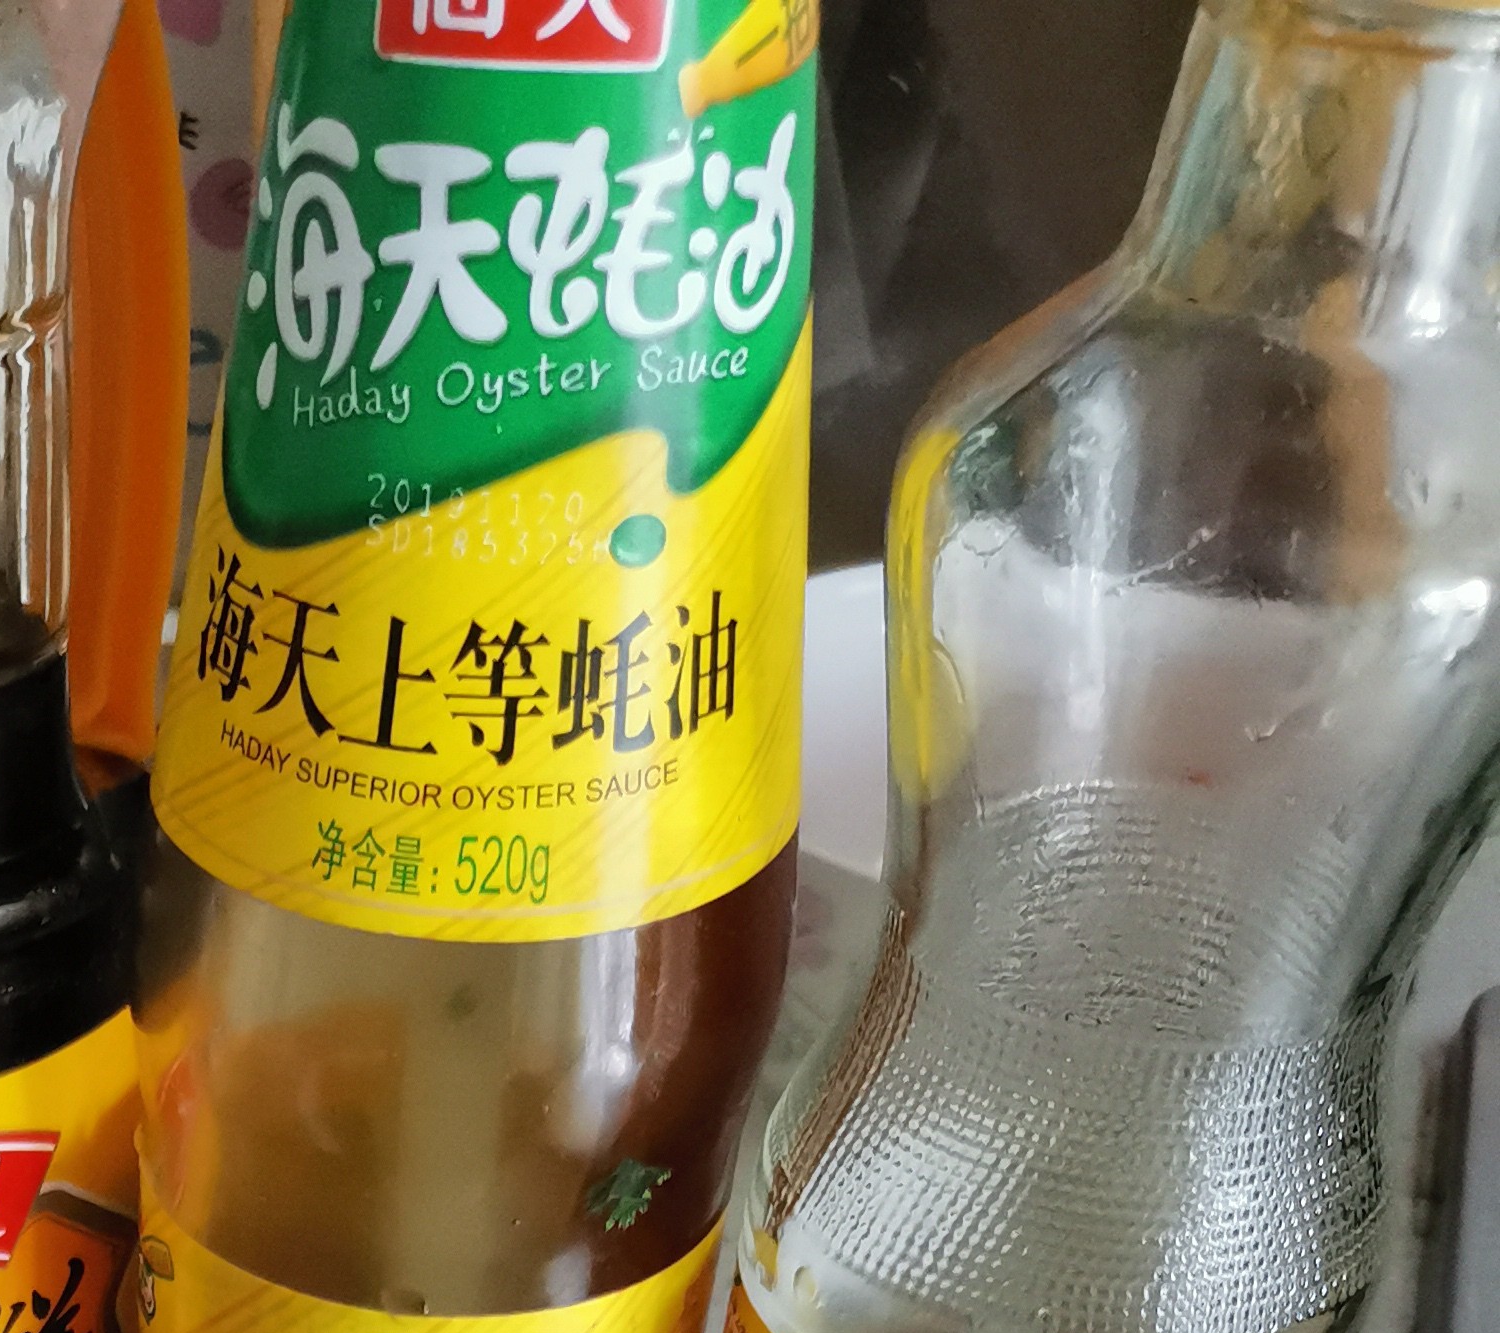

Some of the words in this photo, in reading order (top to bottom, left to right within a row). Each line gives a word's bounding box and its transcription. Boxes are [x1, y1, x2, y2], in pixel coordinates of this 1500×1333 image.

[247, 103, 797, 410] 海天蚝油
[292, 367, 411, 427] Haday
[436, 355, 611, 414] Oyster
[637, 345, 748, 389] Sauce
[198, 544, 737, 767] 海天上等蚝油
[221, 719, 291, 771] HADAY
[295, 757, 441, 809] SUPERIOR
[452, 782, 576, 812] OYSTER
[585, 759, 680, 803] SAUCE
